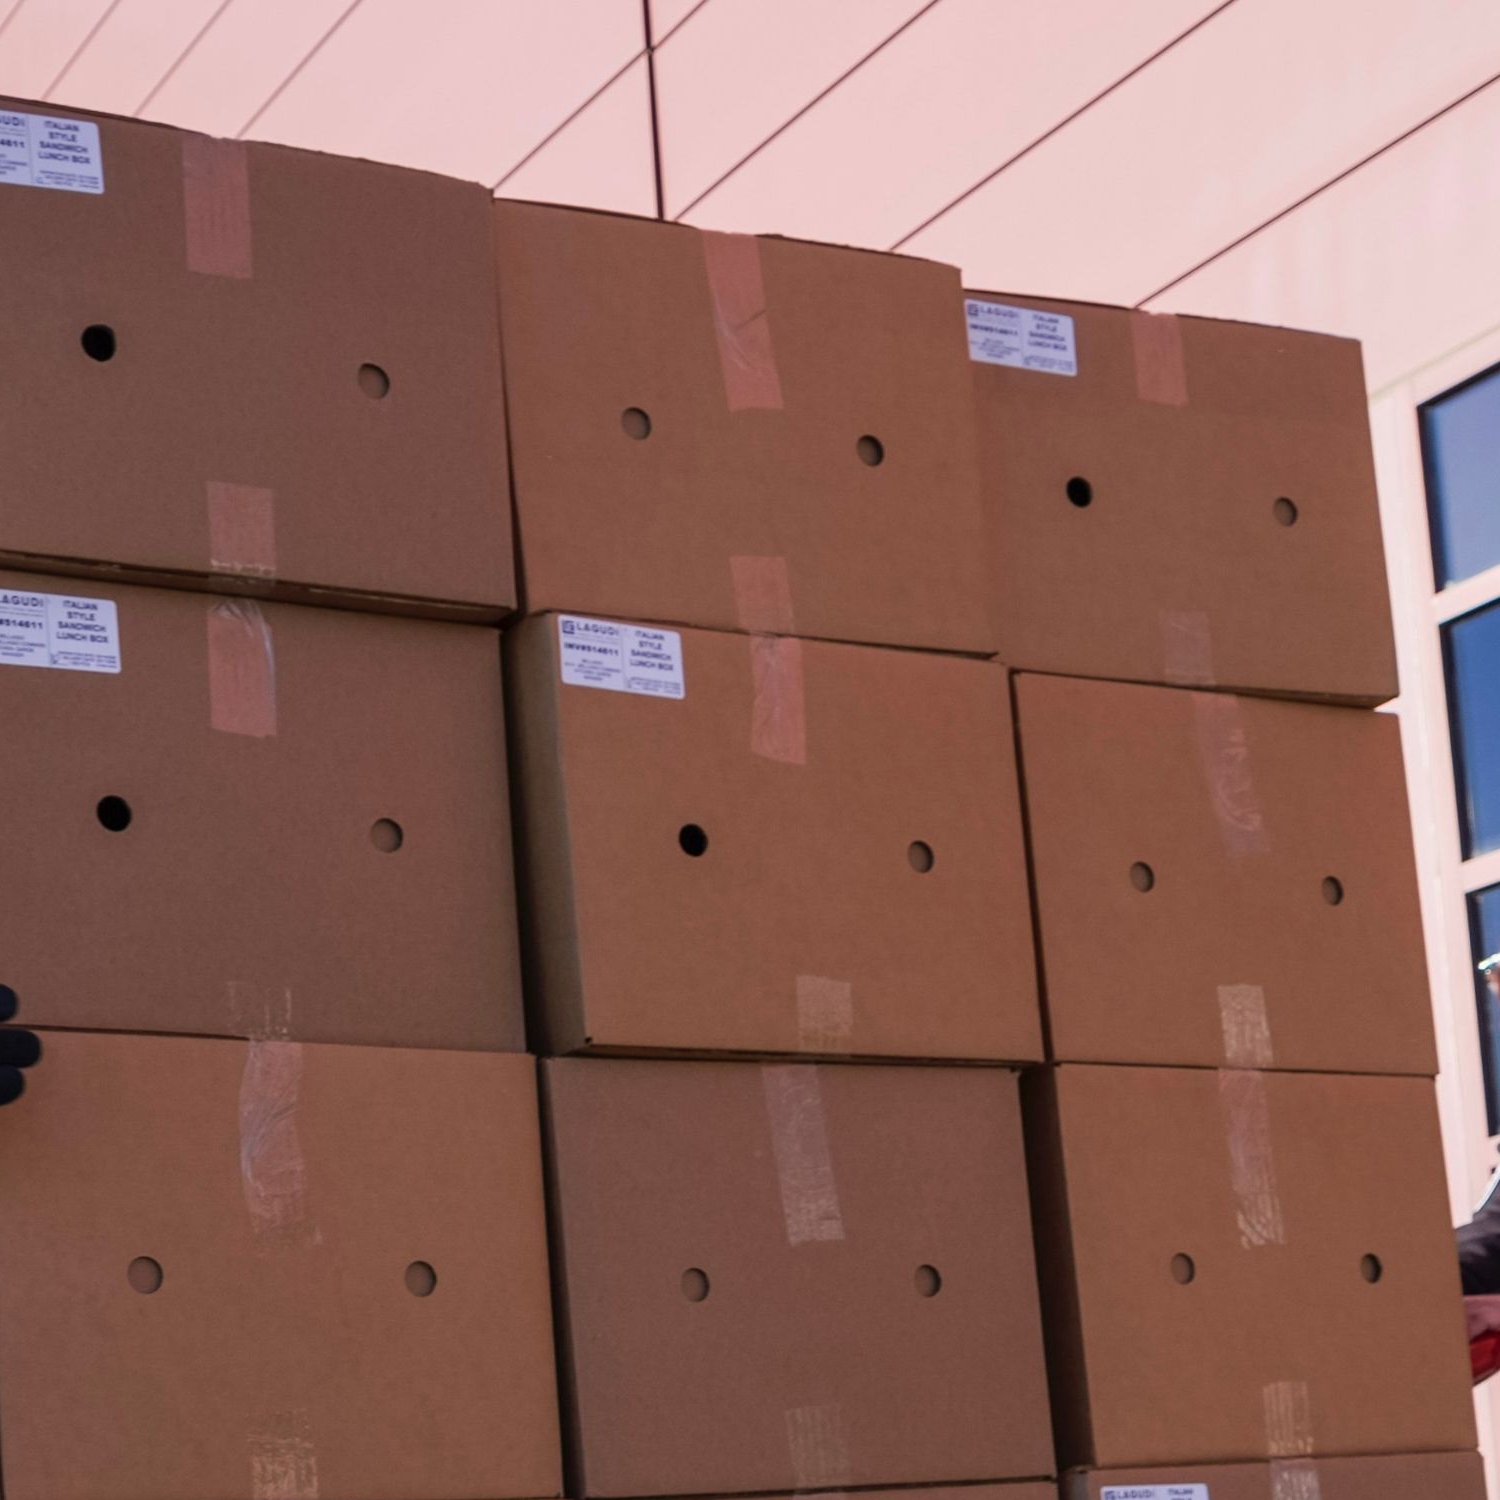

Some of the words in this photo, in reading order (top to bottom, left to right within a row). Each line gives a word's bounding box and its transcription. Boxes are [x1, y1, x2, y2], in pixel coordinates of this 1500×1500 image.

[44, 120, 80, 132] ITALIAN
[49, 131, 77, 142] STYLE
[39, 141, 89, 153] SANDWICH
[38, 152, 69, 162] LUNCH
[72, 155, 91, 165] BOX
[63, 600, 98, 611] ITALIAN
[67, 611, 96, 622] STYLE
[58, 621, 107, 632] SANDWICH
[56, 632, 87, 641] LUNCH
[89, 634, 108, 643] BOX
